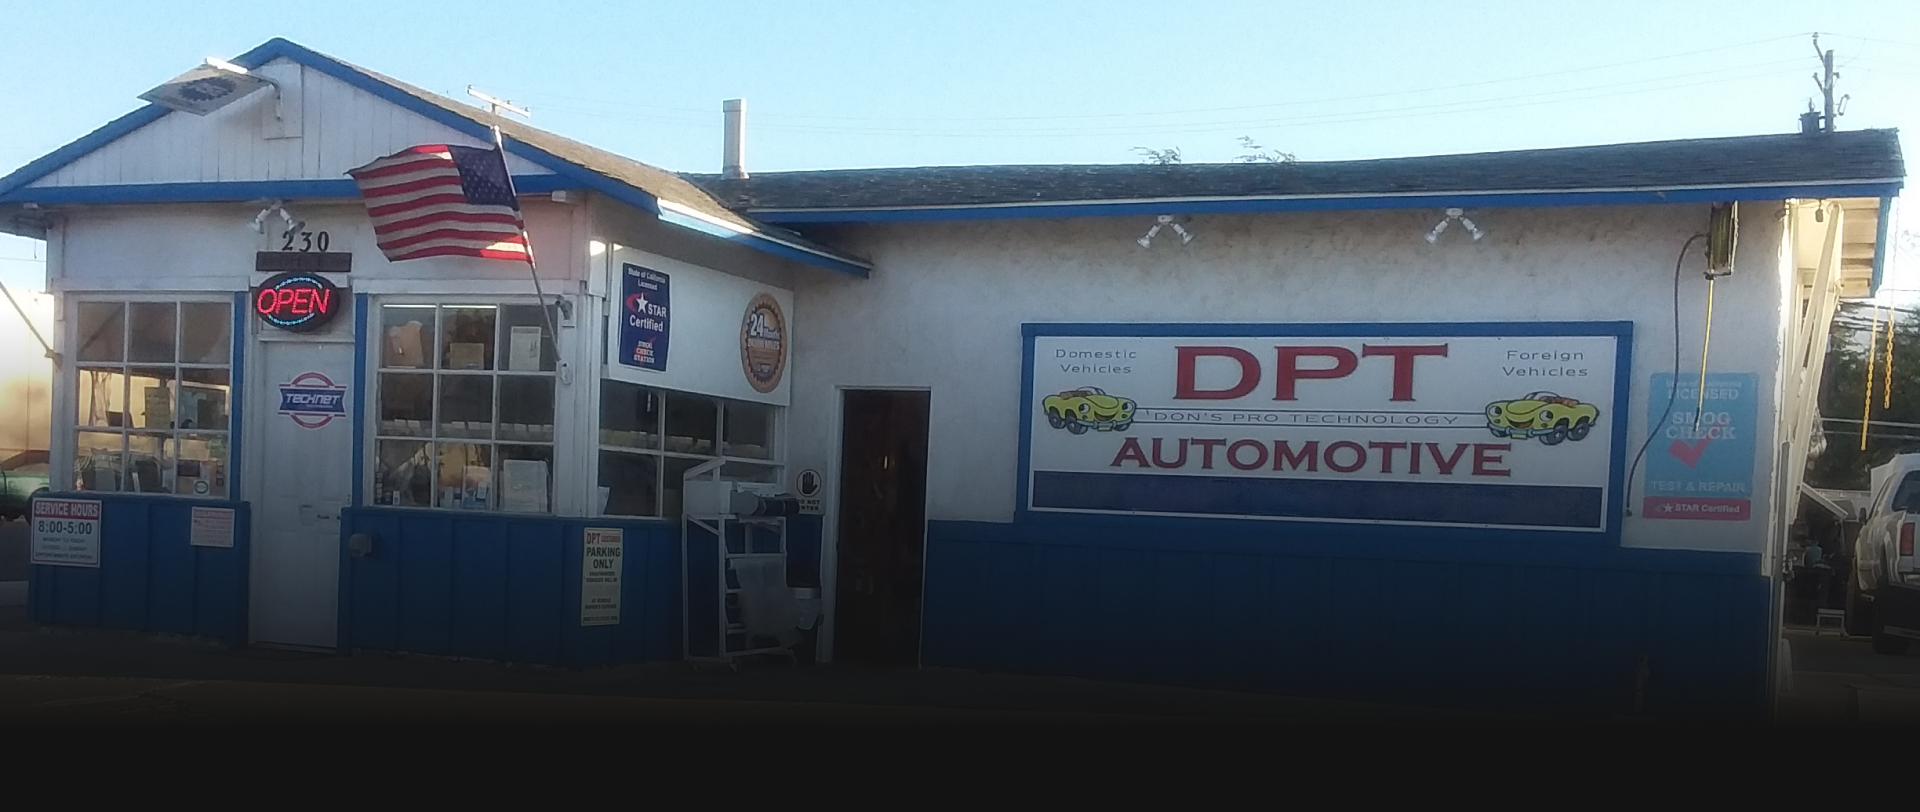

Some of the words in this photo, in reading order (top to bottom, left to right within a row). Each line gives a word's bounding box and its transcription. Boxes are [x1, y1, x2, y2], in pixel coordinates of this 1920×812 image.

[282, 231, 330, 252] 230
[257, 288, 331, 314] OPEN
[647, 303, 667, 318] STAR
[629, 315, 664, 332] Certified
[750, 313, 764, 337] 24
[1055, 348, 1137, 359] Domestic
[1506, 350, 1584, 362] Foreign
[1060, 363, 1132, 374] Vehicles
[1172, 343, 1449, 402] DPT
[1502, 366, 1588, 377] Vehicles
[1233, 413, 1279, 423] PRO
[1289, 414, 1459, 425] TECHNOLOGY
[1665, 426, 1736, 440] CHECK
[1110, 437, 1512, 477] AUTOMOTIVE
[1651, 480, 1681, 491] TEST
[1686, 481, 1695, 491] &
[1698, 481, 1746, 492] REPAIR
[35, 502, 69, 516] SERVICE
[70, 503, 98, 517] HOURS
[1675, 504, 1699, 512] STAR
[1701, 504, 1740, 513] Certified
[38, 520, 92, 535] 8:00-5:00
[586, 532, 601, 545] DPT
[586, 547, 621, 557] PARKING
[592, 559, 614, 569] ONLY
